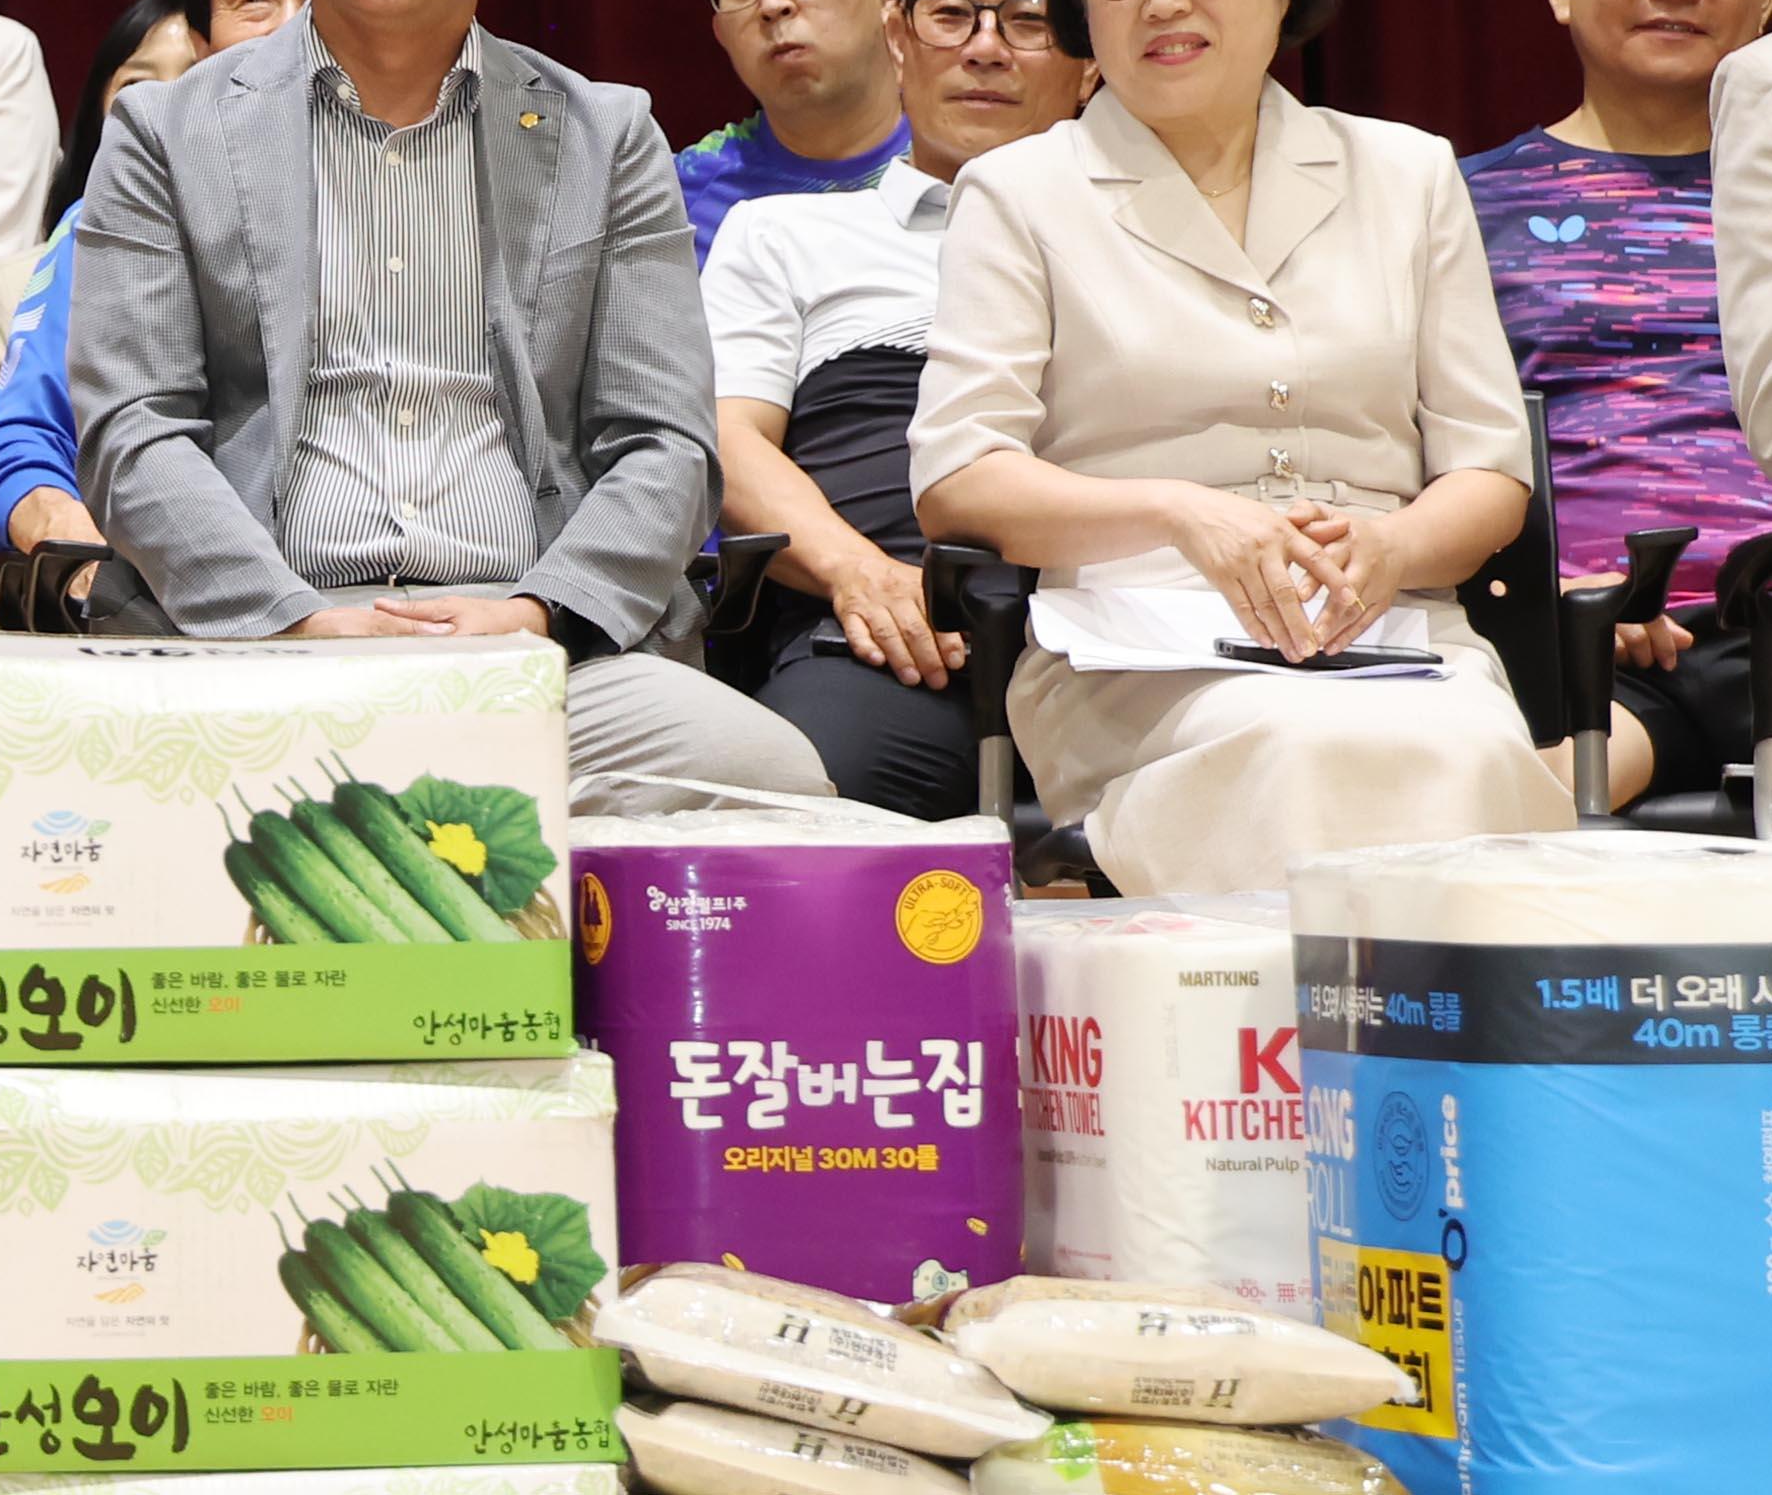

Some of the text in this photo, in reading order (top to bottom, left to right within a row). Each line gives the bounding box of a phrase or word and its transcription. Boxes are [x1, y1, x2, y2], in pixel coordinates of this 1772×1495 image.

[905, 875, 970, 911] ULTRA-SOFT
[699, 916, 732, 932] 1974
[150, 969, 347, 990] 좋은 좋은 물로 자란
[1178, 970, 1260, 987] MARTKING
[1535, 973, 1745, 1012] 1.5배 더 오래
[151, 995, 242, 1015] 신선한 오이
[1385, 992, 1427, 1025] 40m
[1632, 1017, 1721, 1049] 40m
[1029, 1014, 1103, 1088] KING
[669, 1039, 985, 1131] 돈잘버는집
[1065, 1091, 1105, 1137] TOWEL
[1181, 1098, 1305, 1141] KITCHE
[723, 1143, 941, 1173] 오리지널 30M 30롤
[1205, 1156, 1300, 1175] Natural Pulp
[1358, 1263, 1446, 1332] 아파트
[204, 1378, 398, 1399] 좋은 좋은 물로 자란
[204, 1404, 294, 1424] 신선한 오이
